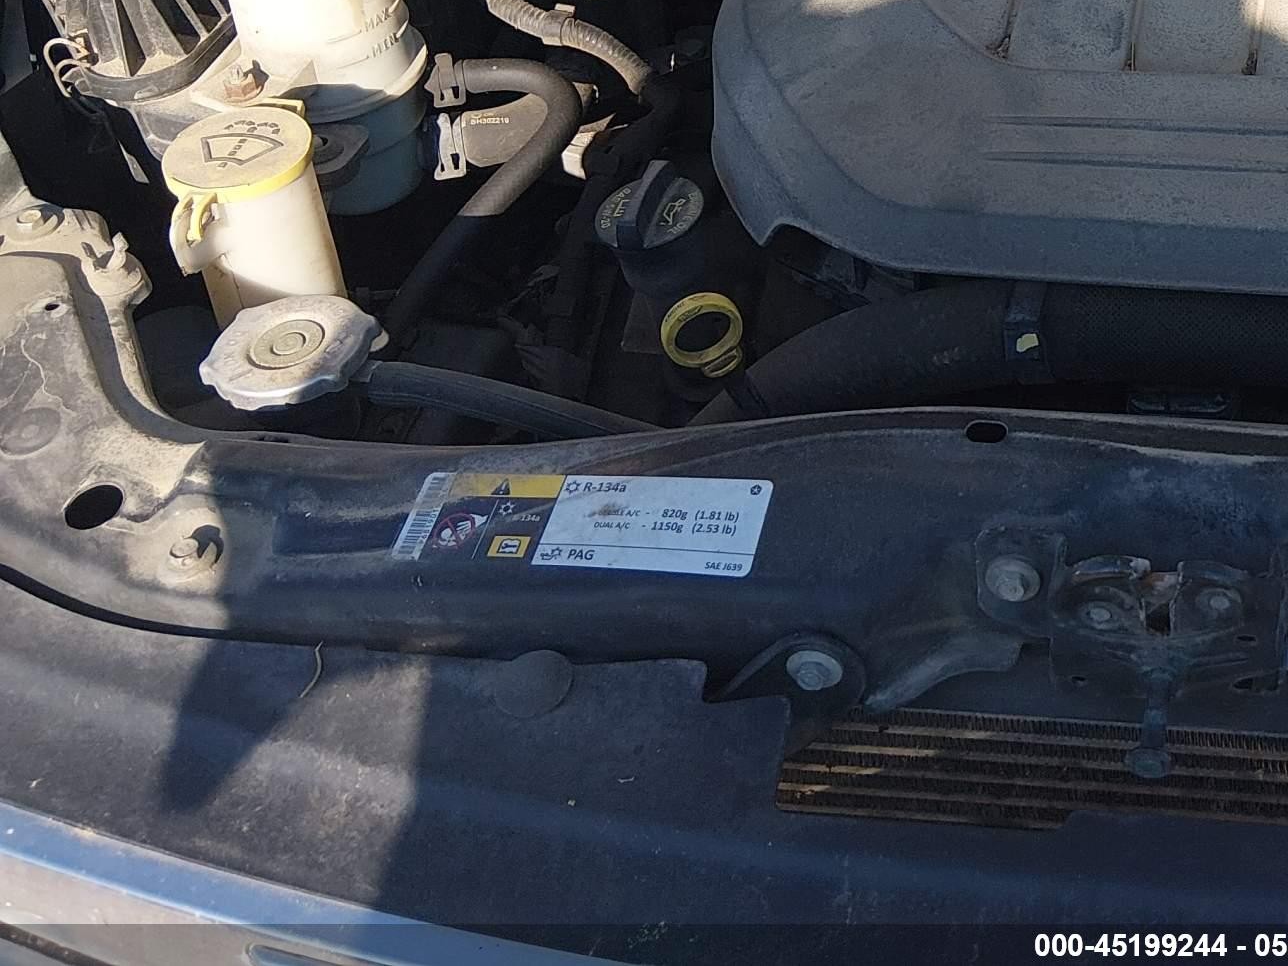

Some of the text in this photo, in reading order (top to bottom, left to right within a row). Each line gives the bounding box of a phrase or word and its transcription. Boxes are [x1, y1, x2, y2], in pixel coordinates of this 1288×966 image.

[364, 7, 392, 32] MAX
[371, 32, 399, 58] MIN
[583, 481, 627, 493] R-134a
[662, 508, 688, 521] 820g
[695, 509, 721, 521] (1.81
[724, 511, 740, 523] lb)
[593, 521, 613, 529] DUAL
[651, 521, 683, 534] 1150g
[692, 522, 719, 535] (2.53
[722, 524, 737, 536] lb)
[567, 548, 595, 561] PAG
[704, 561, 743, 572] SAE J639
